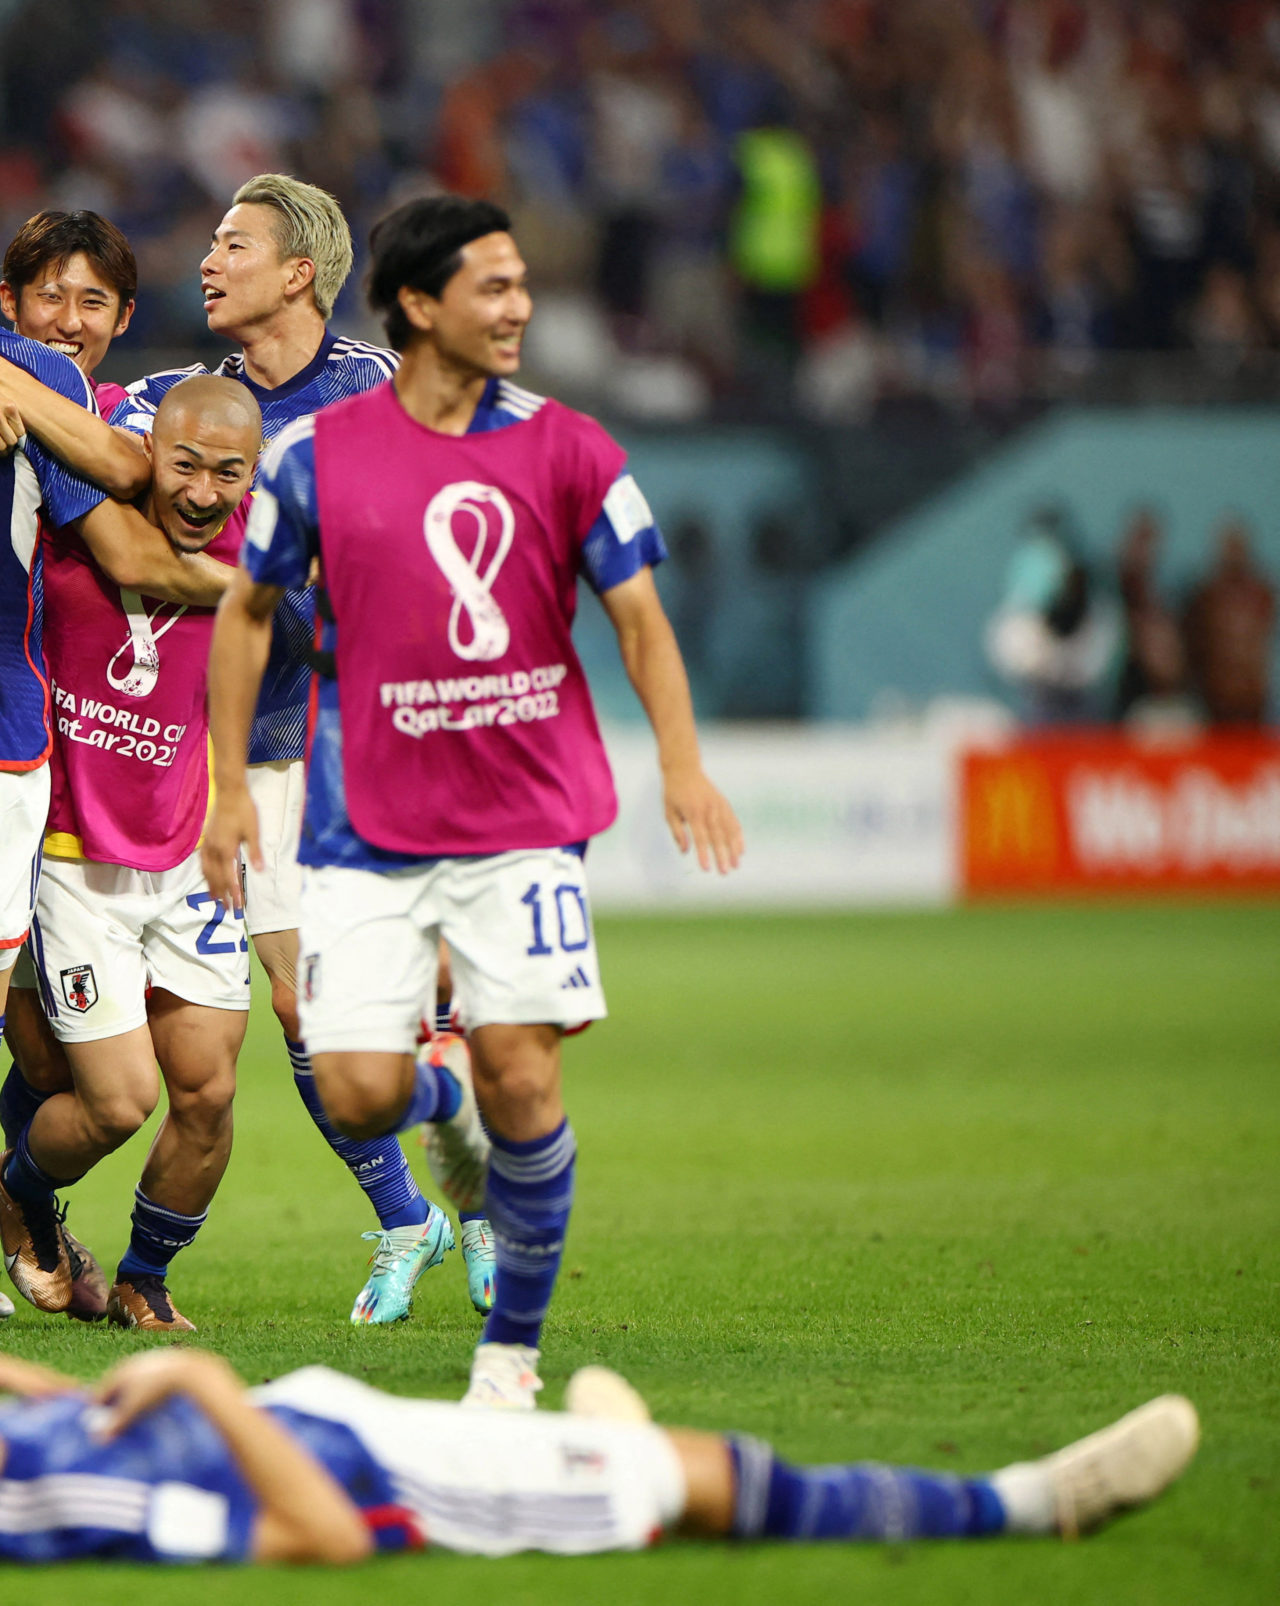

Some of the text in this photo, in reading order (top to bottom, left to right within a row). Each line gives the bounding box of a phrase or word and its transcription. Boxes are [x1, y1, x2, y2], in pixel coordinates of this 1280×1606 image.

[380, 663, 567, 708] FIFA WORLD CUP
[80, 698, 161, 737] WORLD
[520, 882, 589, 956] 10
